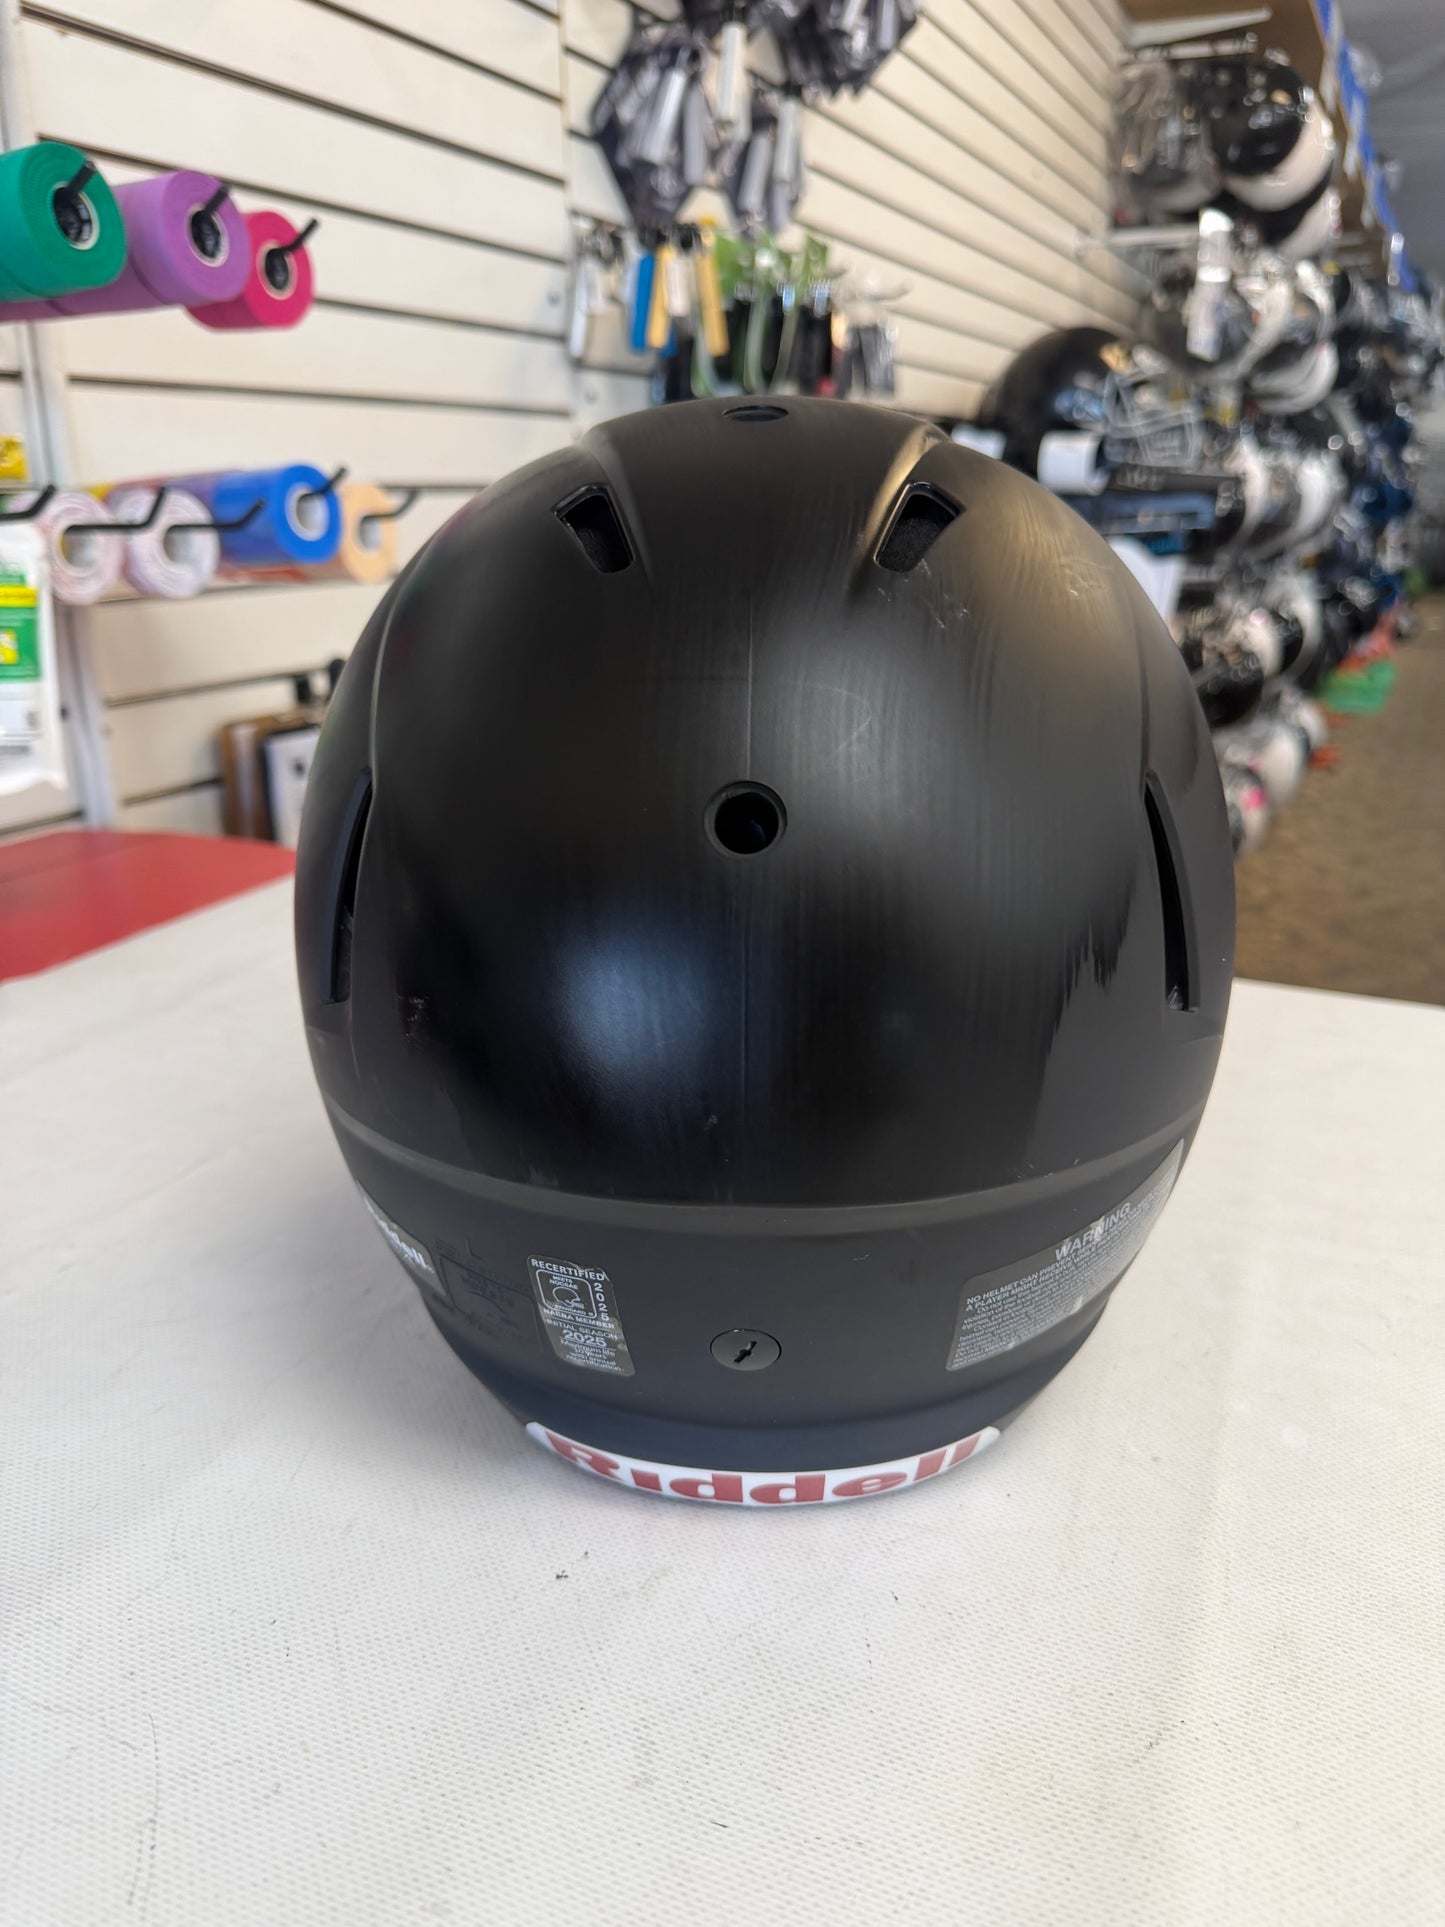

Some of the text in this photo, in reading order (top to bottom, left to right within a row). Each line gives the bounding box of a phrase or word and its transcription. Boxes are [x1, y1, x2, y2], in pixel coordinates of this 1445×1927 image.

[1055, 1202, 1131, 1261] WARNING
[531, 1258, 605, 1281] RECERTIFIED
[967, 1253, 1077, 1305] NO HELMET CAN PREVENT
[965, 1304, 974, 1312] A
[974, 1292, 1010, 1309] PLAYER
[1011, 1280, 1037, 1295] MIGHT
[546, 1318, 618, 1340] INITIAL SEASON
[575, 1316, 615, 1329] MEMBER
[562, 1329, 608, 1348] 2025
[545, 1430, 981, 1504] Riddell
